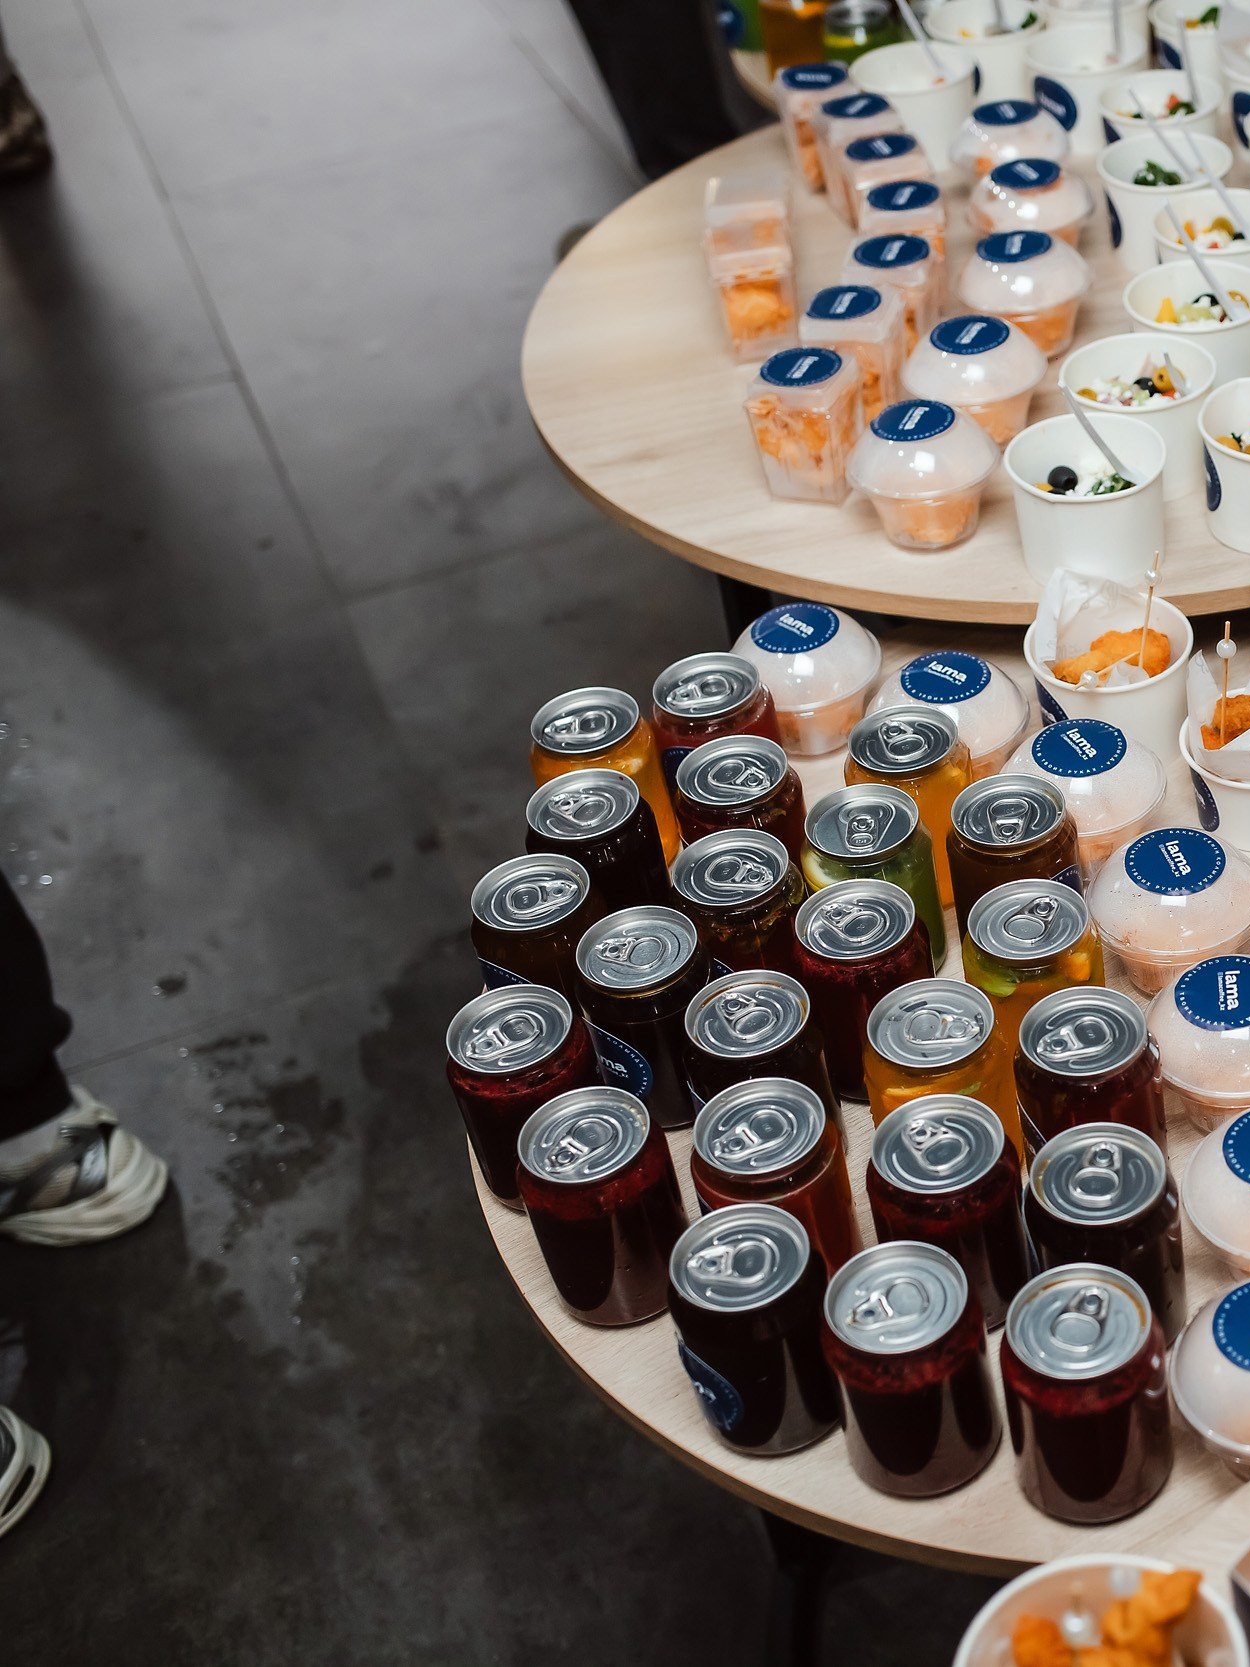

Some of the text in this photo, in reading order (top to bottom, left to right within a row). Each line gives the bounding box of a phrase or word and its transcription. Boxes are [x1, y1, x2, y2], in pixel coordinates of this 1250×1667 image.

[779, 613, 814, 636] lama
[928, 660, 968, 682] lama
[1066, 728, 1097, 758] lama
[1165, 840, 1191, 876] lama
[1224, 970, 1240, 1010] lama
[600, 1055, 627, 1073] ma
